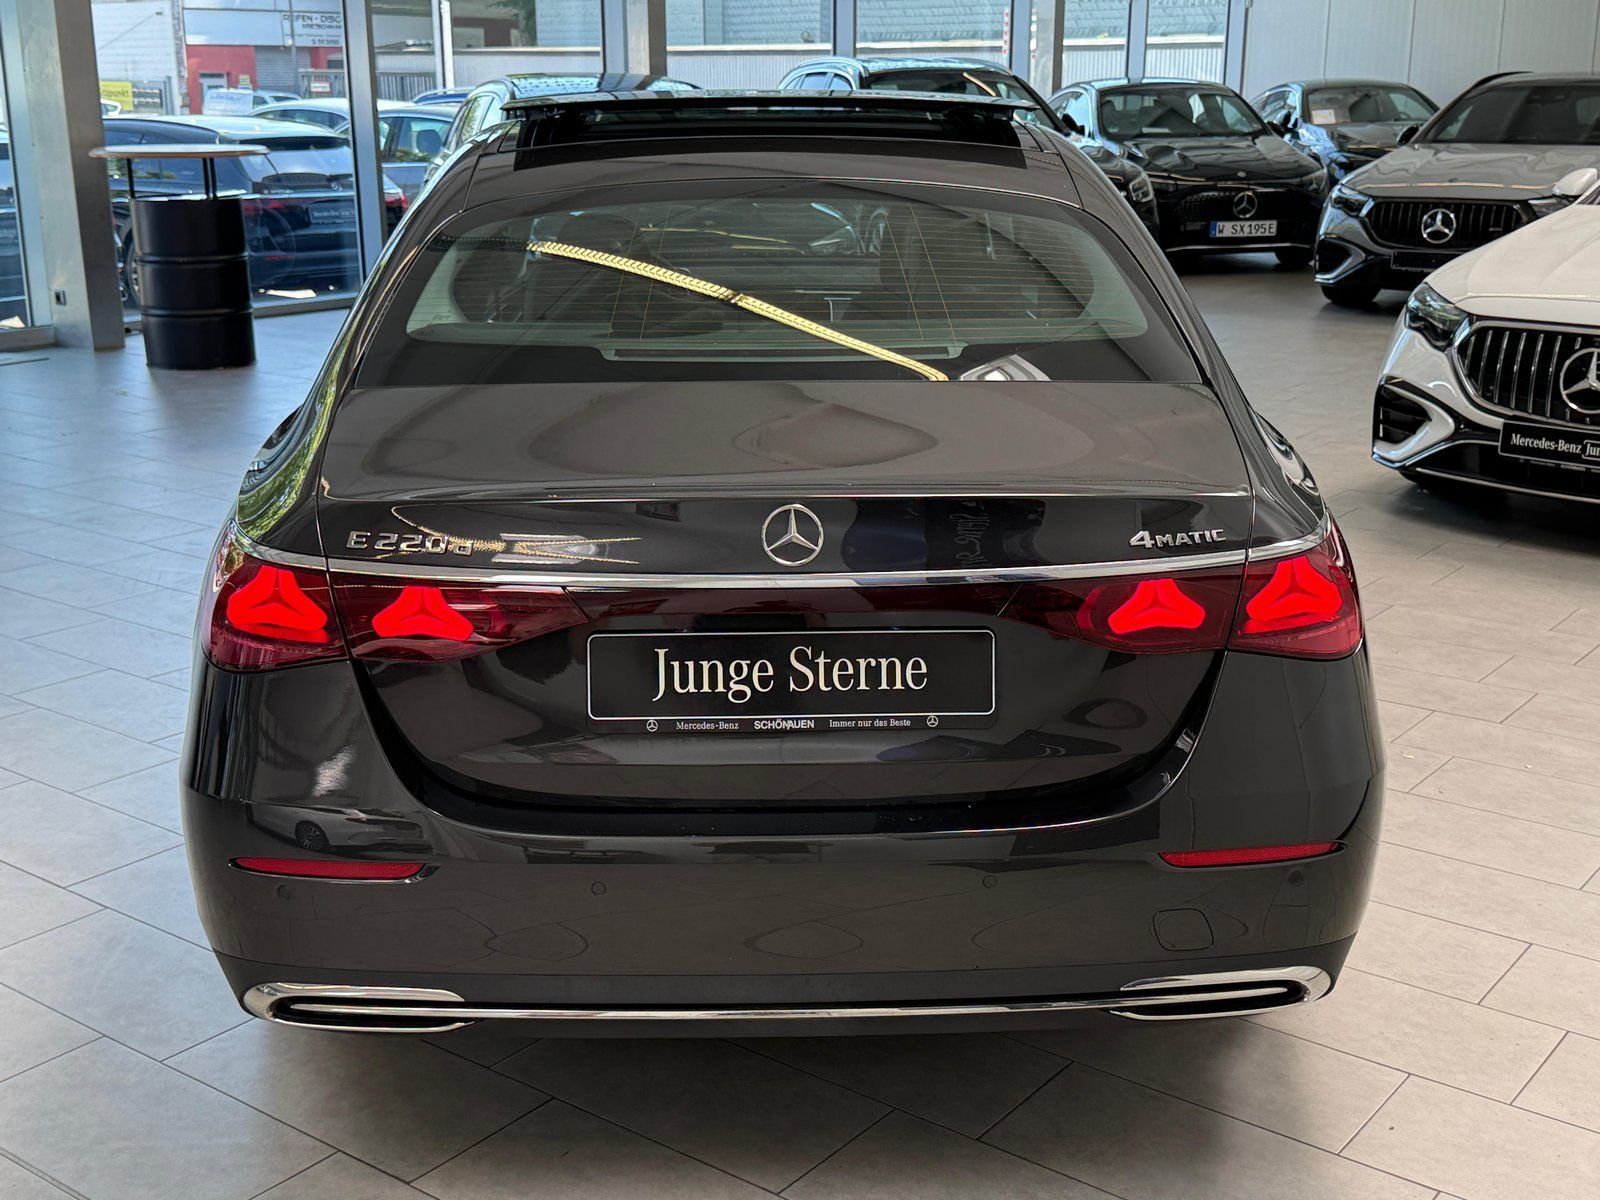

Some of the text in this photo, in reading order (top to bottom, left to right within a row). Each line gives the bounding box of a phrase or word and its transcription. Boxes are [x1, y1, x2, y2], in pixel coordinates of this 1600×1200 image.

[1218, 224, 1225, 234] W
[1510, 433, 1582, 454] Mercedes-Benz
[346, 531, 371, 549] E
[1129, 529, 1226, 548] 4MATIC
[652, 646, 928, 704] Junge Sterne
[675, 721, 740, 731] Mercedes-Benz
[753, 719, 815, 730] SCHÖNAUEN
[829, 719, 855, 728] Immer
[873, 719, 888, 727] das
[890, 718, 911, 727] Beste
